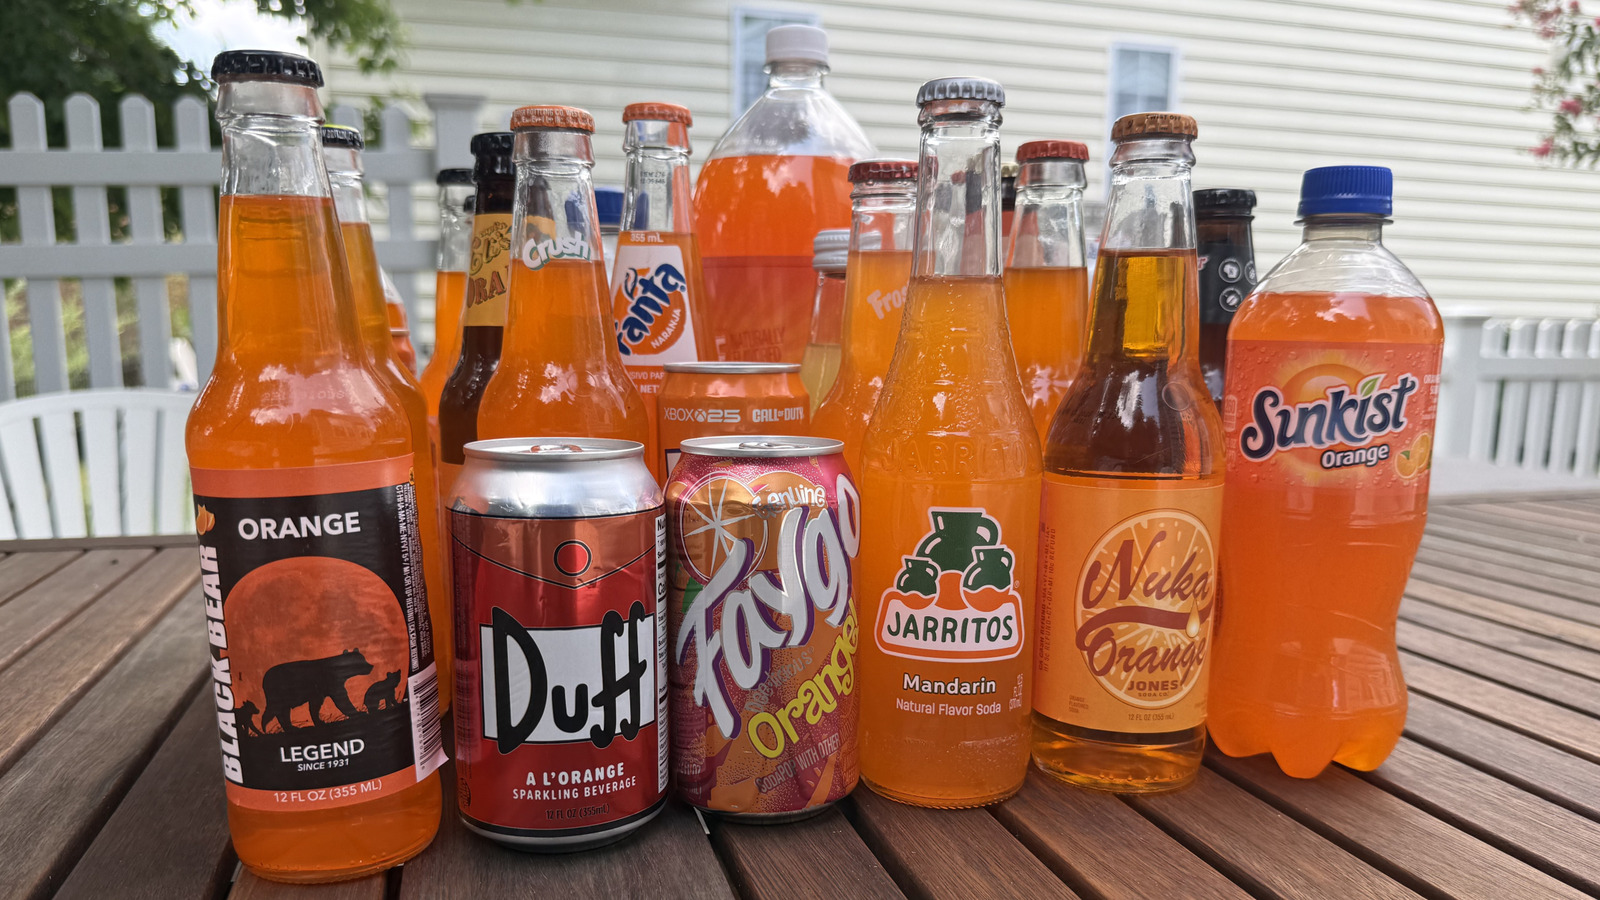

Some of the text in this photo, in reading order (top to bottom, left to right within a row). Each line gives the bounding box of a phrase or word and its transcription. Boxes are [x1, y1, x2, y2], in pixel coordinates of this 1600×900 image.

[630, 233, 663, 243] 355 mL
[522, 231, 591, 271] Crush
[467, 265, 508, 308] ORA
[651, 308, 682, 349] NARANJA
[631, 371, 648, 380] SIVO
[640, 384, 660, 394] NET
[664, 407, 741, 422] XBOX 25
[752, 409, 778, 423] CALL
[784, 407, 804, 421] DUTY
[1241, 375, 1417, 460] Sunkist
[1321, 445, 1389, 468] Orange
[752, 484, 825, 519] Genuine
[237, 511, 361, 541] ORANGE
[1082, 531, 1210, 610] Nuka
[676, 473, 861, 739] Faygo
[887, 611, 1013, 644] JARRITOS
[199, 545, 244, 784] BLACK BEAR
[1086, 627, 1206, 687] Orange
[492, 601, 647, 755] Duff
[902, 673, 997, 696] Mandarin
[1127, 680, 1179, 691] JONES
[896, 697, 1002, 716] Natural Flavor Soda
[1128, 713, 1135, 721] 12
[1135, 713, 1143, 721] FL
[1143, 713, 1151, 721] OZ
[280, 738, 365, 763] LEGEND
[795, 747, 820, 771] WITH
[818, 732, 841, 759] OTHER
[297, 758, 350, 772] SINCE 1931
[526, 762, 625, 787] A L’ORANGE
[273, 779, 383, 803] 12 FL OZ (355 ML)
[513, 775, 637, 801] SPARKLING BEVERAGE
[545, 809, 555, 820] 12
[557, 809, 564, 820] FL
[566, 808, 577, 820] OZ
